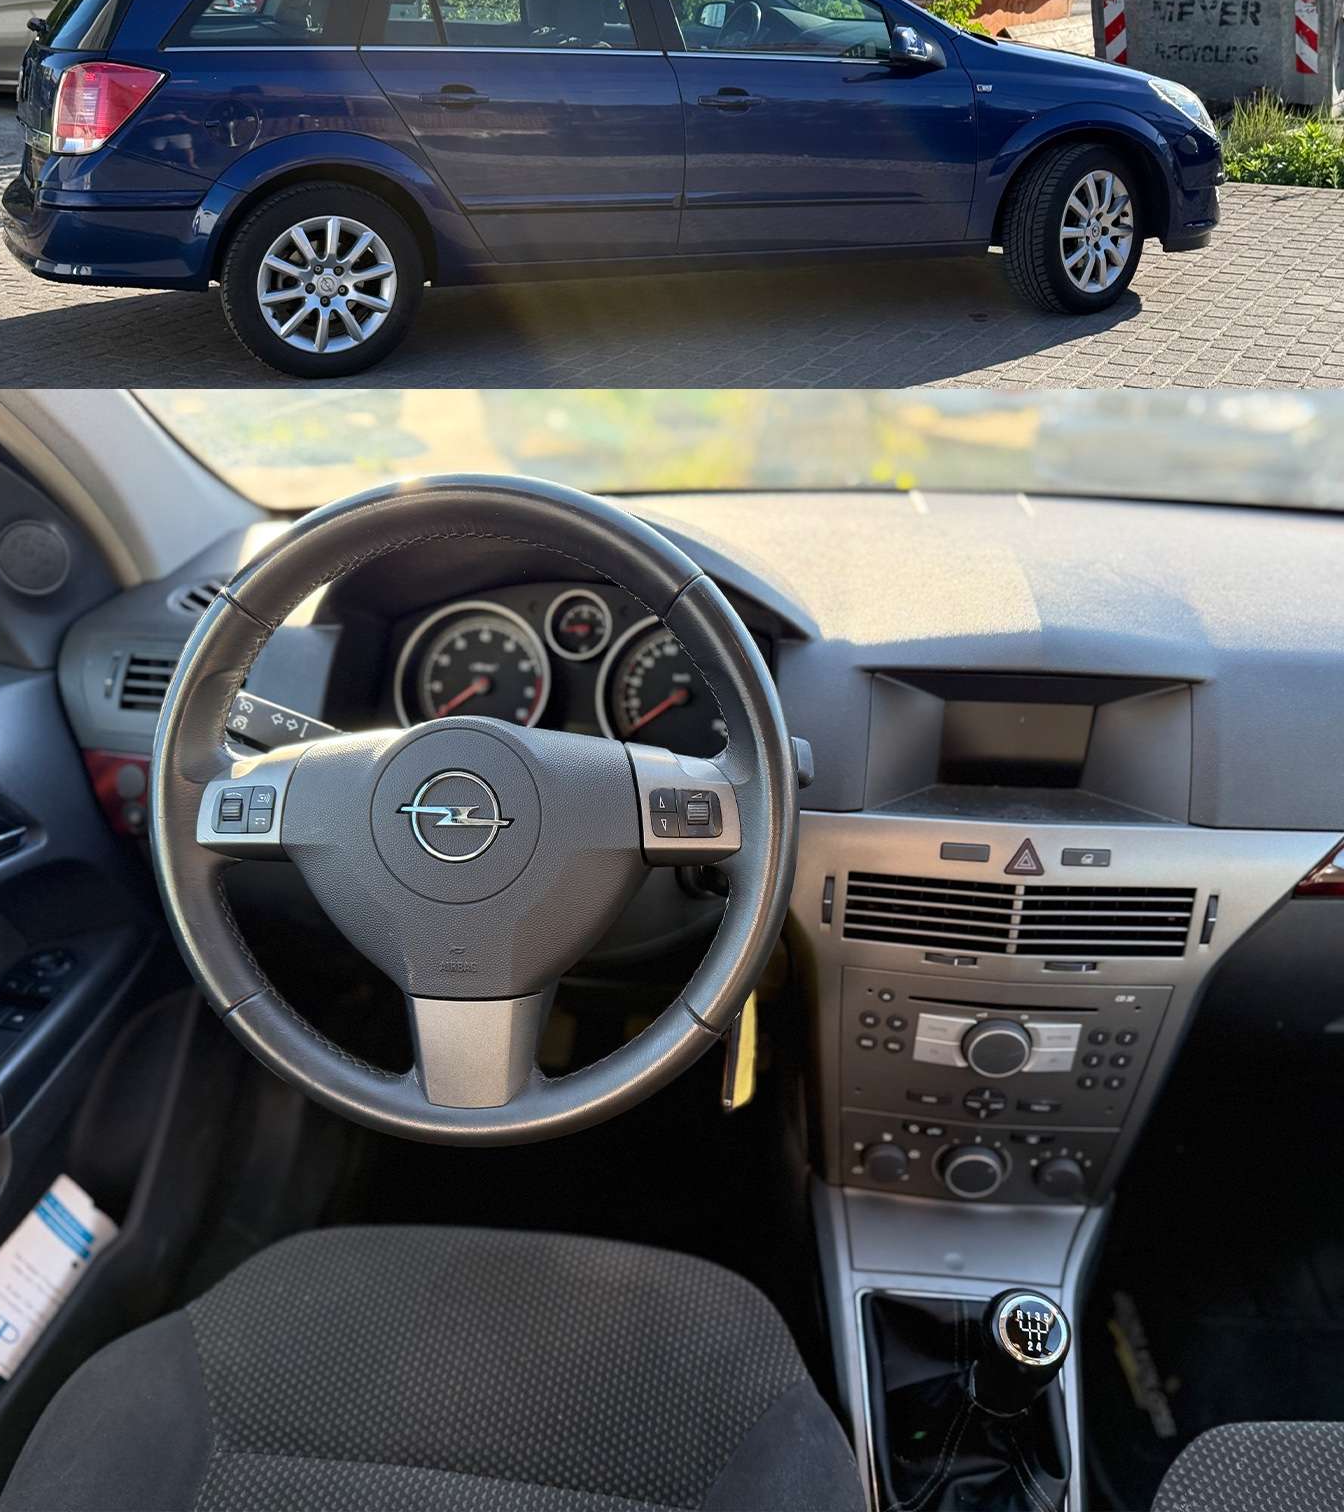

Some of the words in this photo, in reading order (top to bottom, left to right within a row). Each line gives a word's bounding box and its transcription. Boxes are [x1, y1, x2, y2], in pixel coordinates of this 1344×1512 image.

[1016, 1309, 1023, 1320] R
[1034, 1311, 1041, 1322] 3
[1027, 1341, 1033, 1352] 2
[1036, 1341, 1042, 1353] 4
